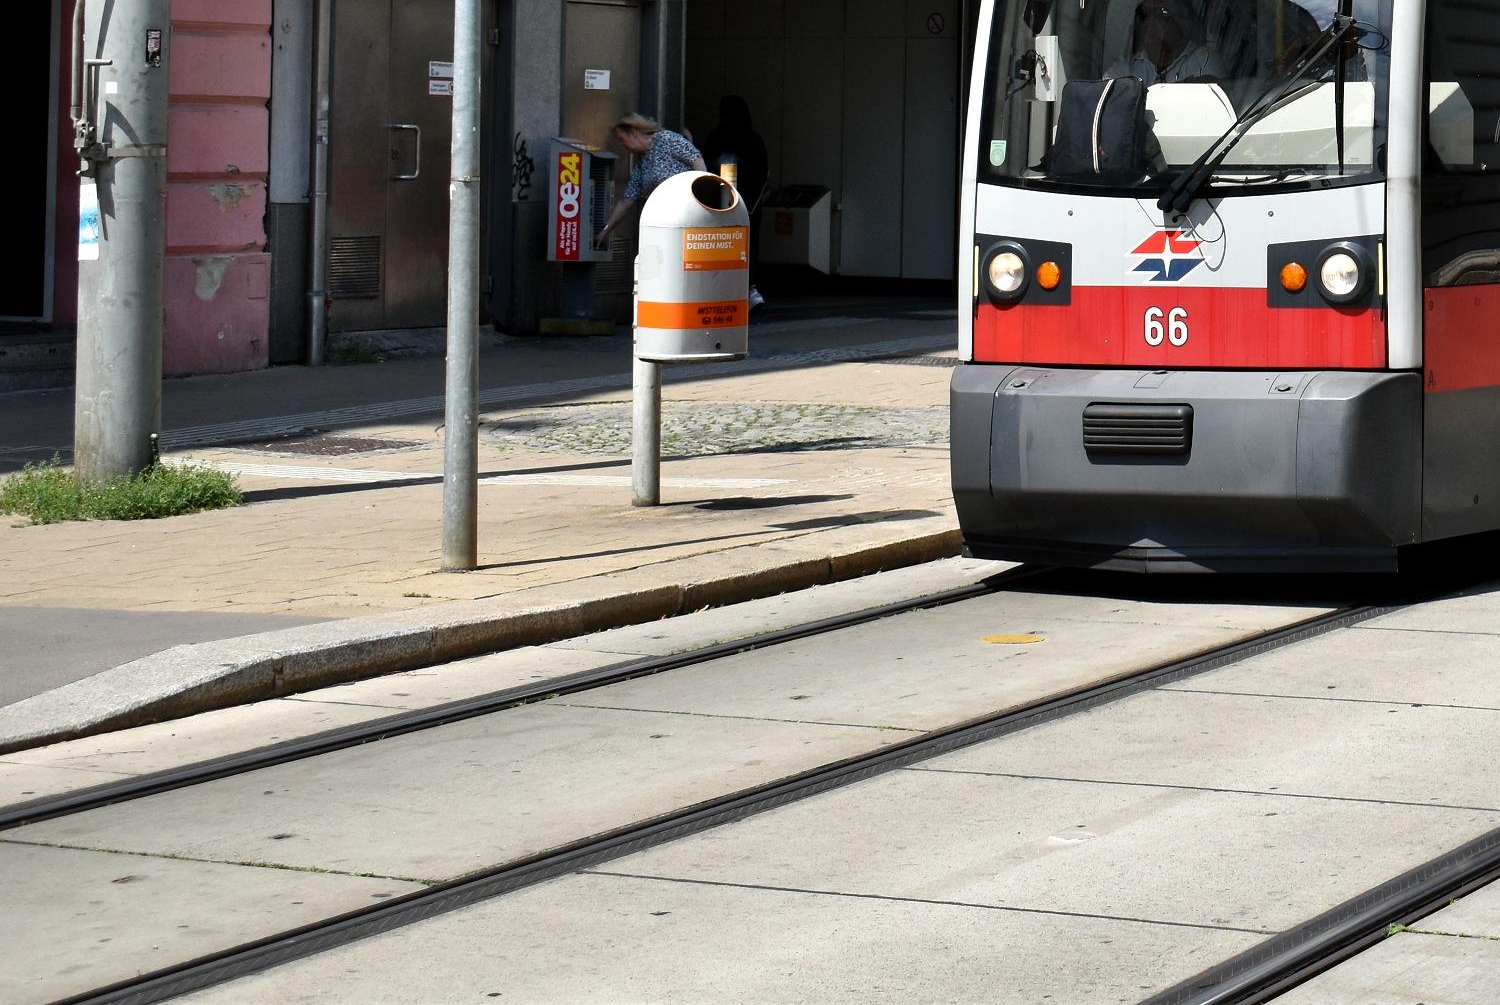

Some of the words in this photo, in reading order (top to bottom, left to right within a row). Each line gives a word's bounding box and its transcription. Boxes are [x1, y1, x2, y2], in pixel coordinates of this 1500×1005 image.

[560, 153, 580, 218] oe24
[687, 233, 732, 241] ENDSTATION
[732, 230, 744, 239] FÜR
[687, 242, 715, 250] DEINEN
[716, 241, 734, 249] MIST.
[1144, 306, 1188, 347] 66
